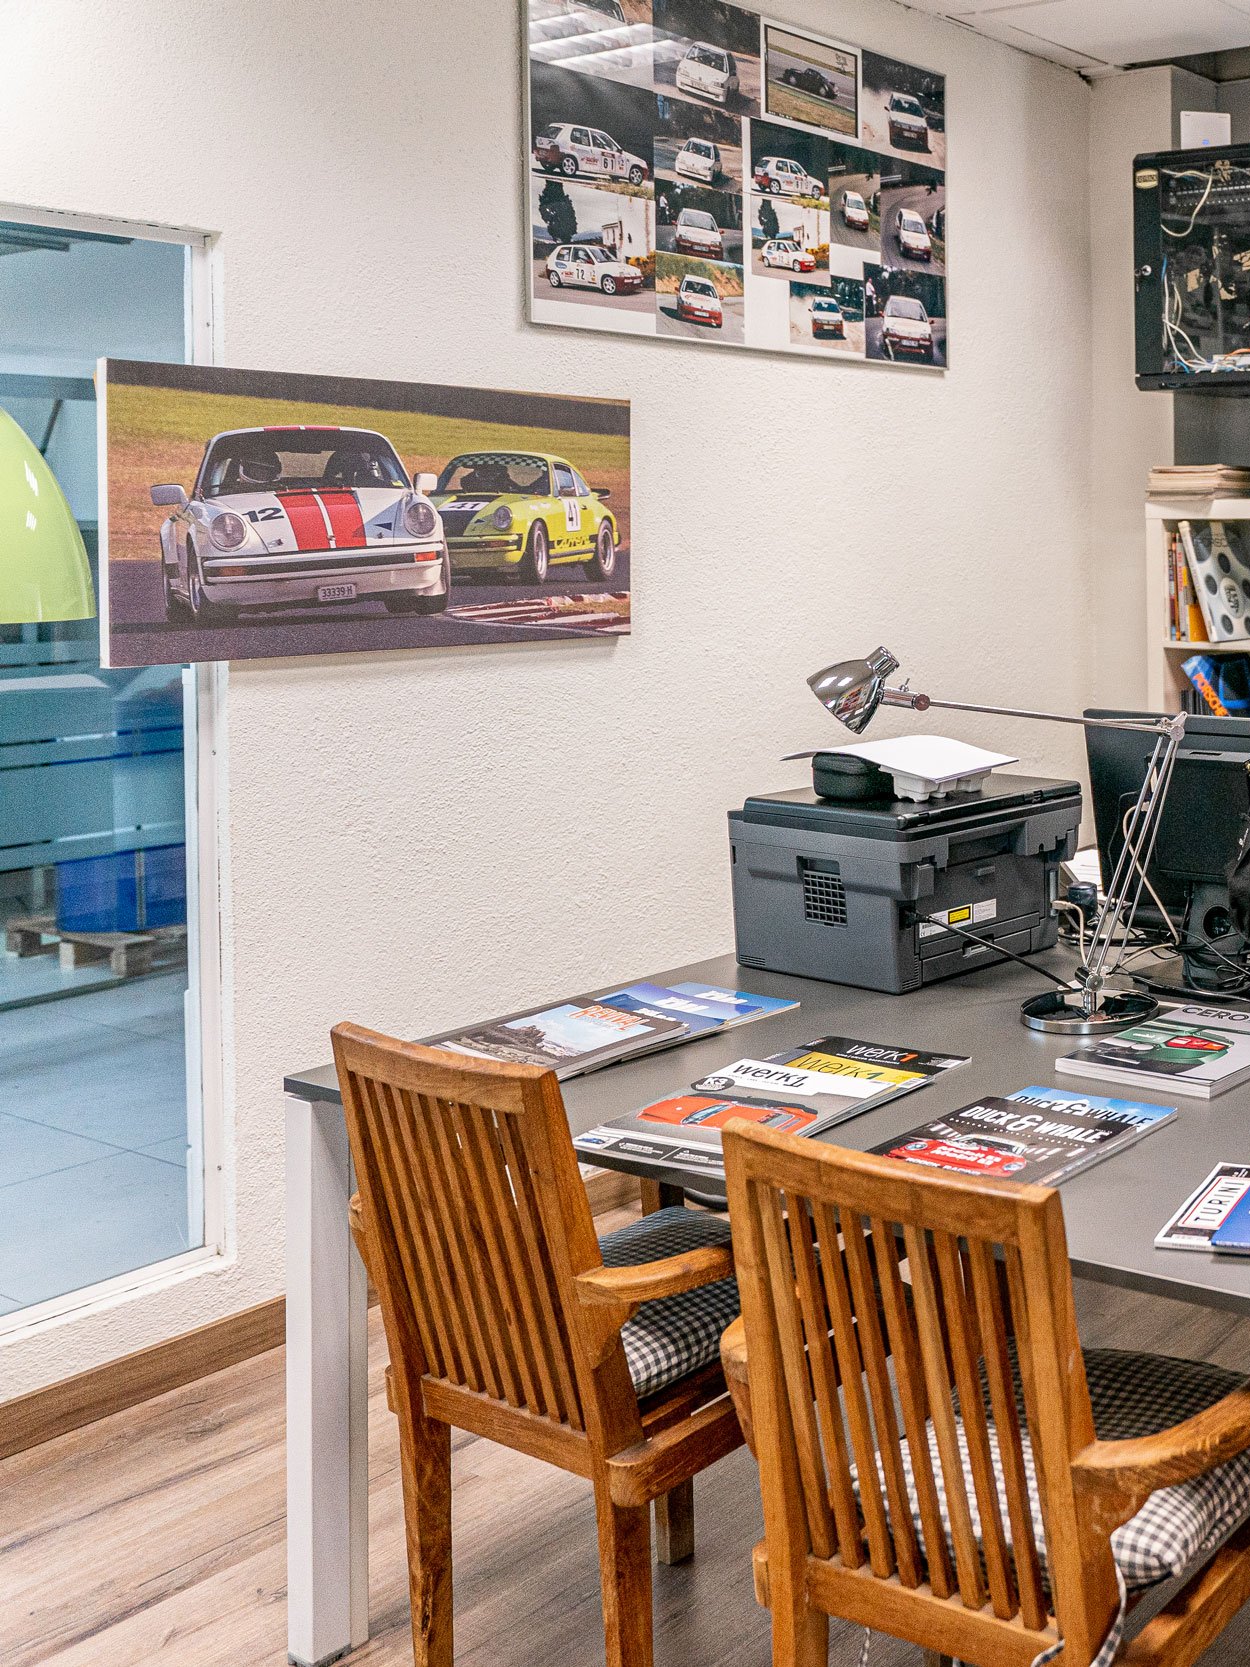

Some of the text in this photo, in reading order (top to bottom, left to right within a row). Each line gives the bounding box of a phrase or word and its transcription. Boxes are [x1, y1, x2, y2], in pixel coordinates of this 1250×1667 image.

[603, 157, 615, 171] 61
[242, 507, 285, 523] 12
[451, 501, 482, 511] 41
[568, 500, 580, 528] 41
[1192, 671, 1230, 716] PORSCHE
[568, 1004, 651, 1031] REVIVAL
[1182, 1006, 1250, 1021] CERO
[845, 1044, 919, 1063] werk1
[732, 1064, 810, 1088] werk1
[798, 1056, 885, 1080] werk1
[958, 1105, 1020, 1126] DUCK
[1005, 1114, 1044, 1132] &
[1033, 1120, 1107, 1144] WHALE
[1193, 1181, 1245, 1223] TURINI
